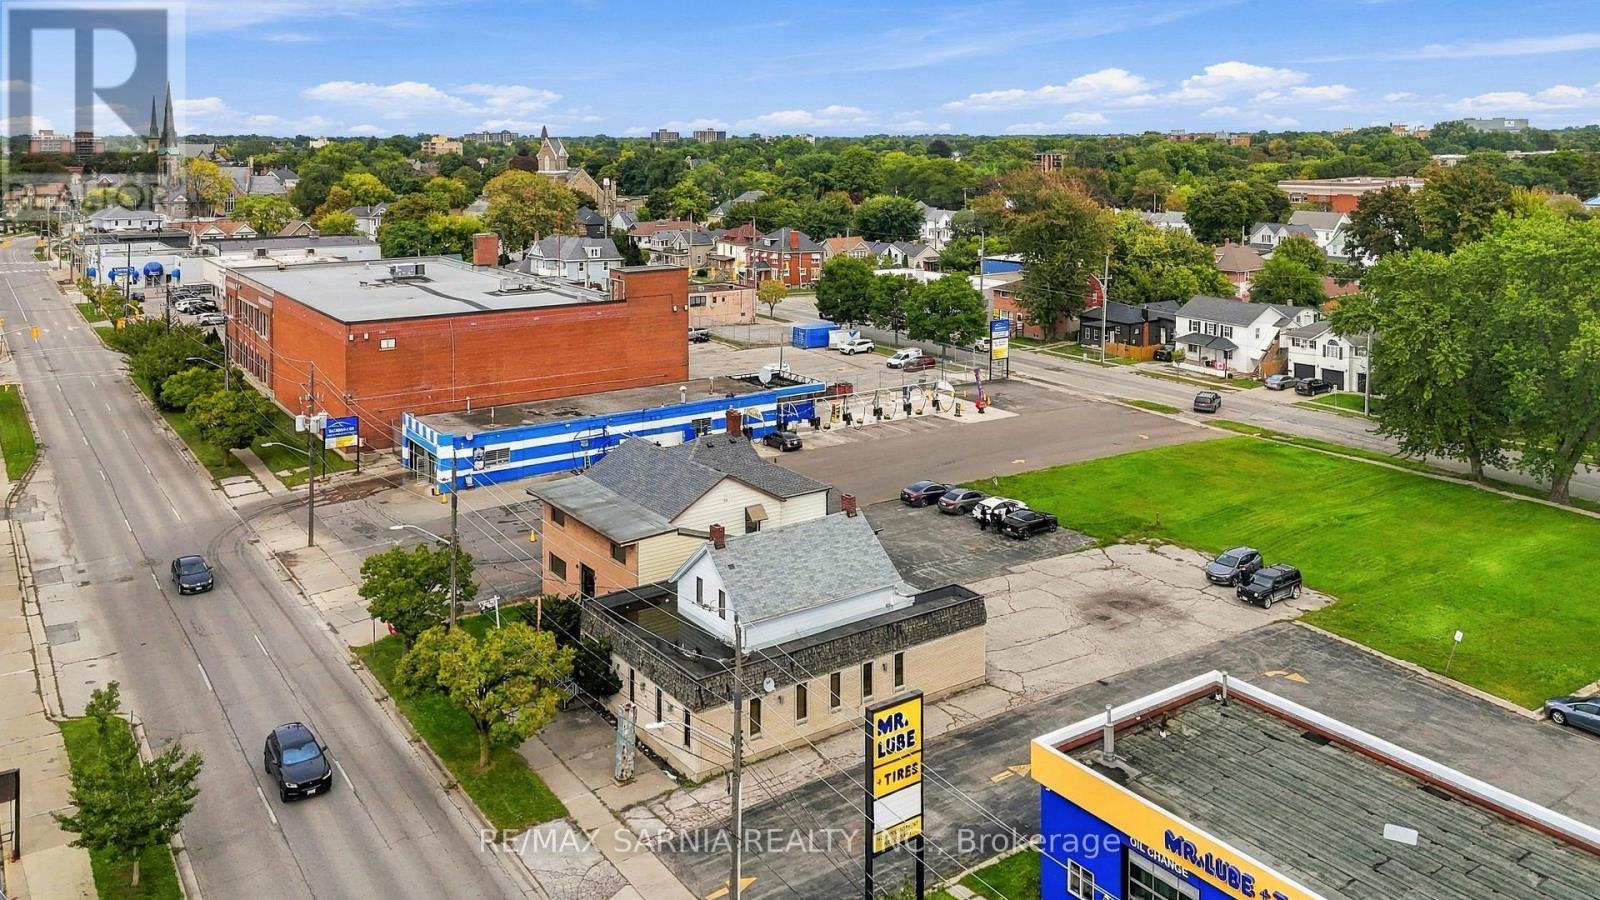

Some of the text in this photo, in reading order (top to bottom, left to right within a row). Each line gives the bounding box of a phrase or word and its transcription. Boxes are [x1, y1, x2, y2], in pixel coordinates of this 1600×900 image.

[877, 712, 909, 736] MR.
[877, 729, 916, 759] LUBE
[884, 763, 918, 785] TIRES
[1130, 837, 1189, 878] OIL CHANGE
[1164, 830, 1204, 868] MR.
[1204, 853, 1255, 897] LUBE
